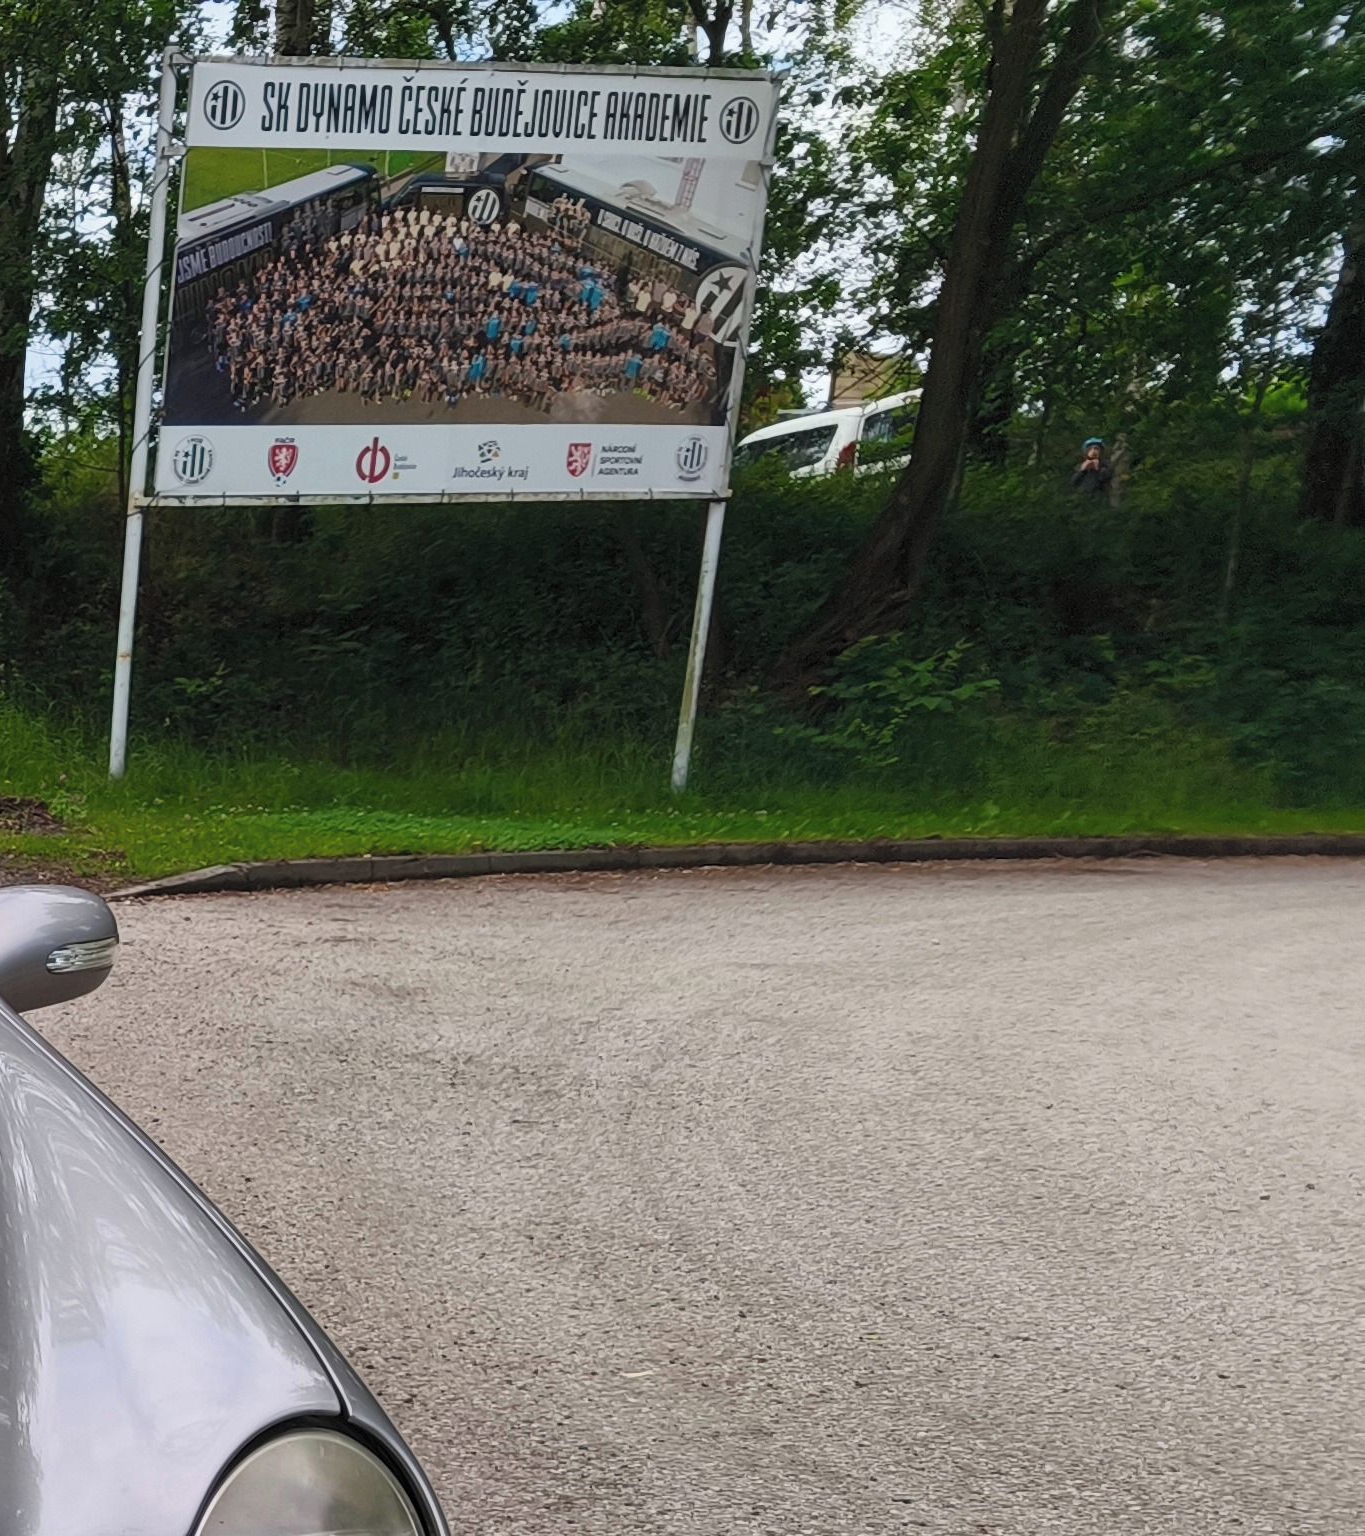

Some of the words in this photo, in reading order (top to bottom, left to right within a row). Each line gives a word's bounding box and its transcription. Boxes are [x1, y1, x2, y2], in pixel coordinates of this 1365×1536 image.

[260, 81, 291, 133] SK
[296, 82, 393, 134] DYNAMO
[398, 75, 469, 136] ČESKÉ
[469, 79, 600, 140] BUDĚJOVICE
[603, 91, 712, 144] AKADEMIE
[178, 249, 209, 283] JSME
[452, 465, 506, 481] Jihočeský
[508, 465, 530, 481] kraj
